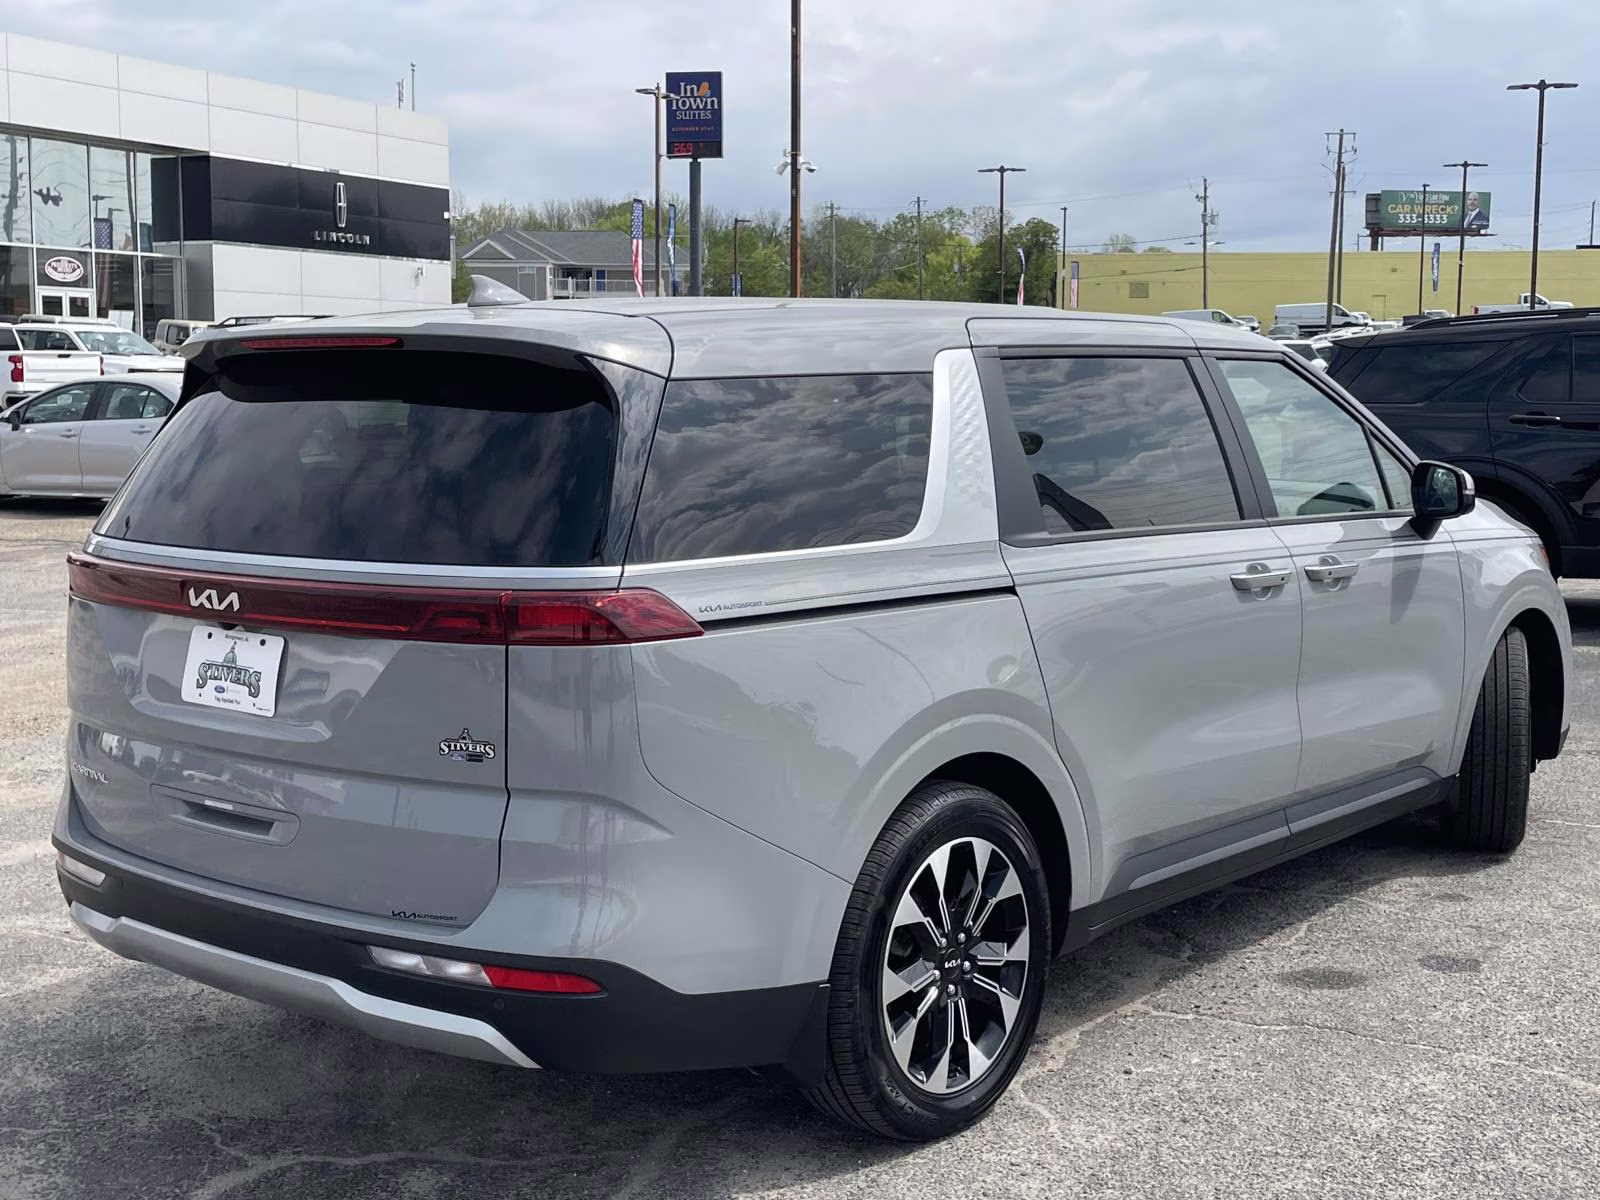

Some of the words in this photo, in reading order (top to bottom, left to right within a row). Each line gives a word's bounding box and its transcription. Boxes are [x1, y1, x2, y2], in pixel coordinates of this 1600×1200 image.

[680, 82, 697, 97] In
[676, 110, 712, 120] SUITES
[1387, 203, 1411, 214] CAR
[1414, 204, 1459, 215] WRECK?
[1398, 213, 1448, 224] 333-3333
[314, 230, 370, 245] LINCOLN
[188, 586, 240, 612] KIA
[723, 601, 763, 611] AUTOSPORT
[196, 661, 262, 699] STIVERS
[439, 740, 495, 760] STIVERS
